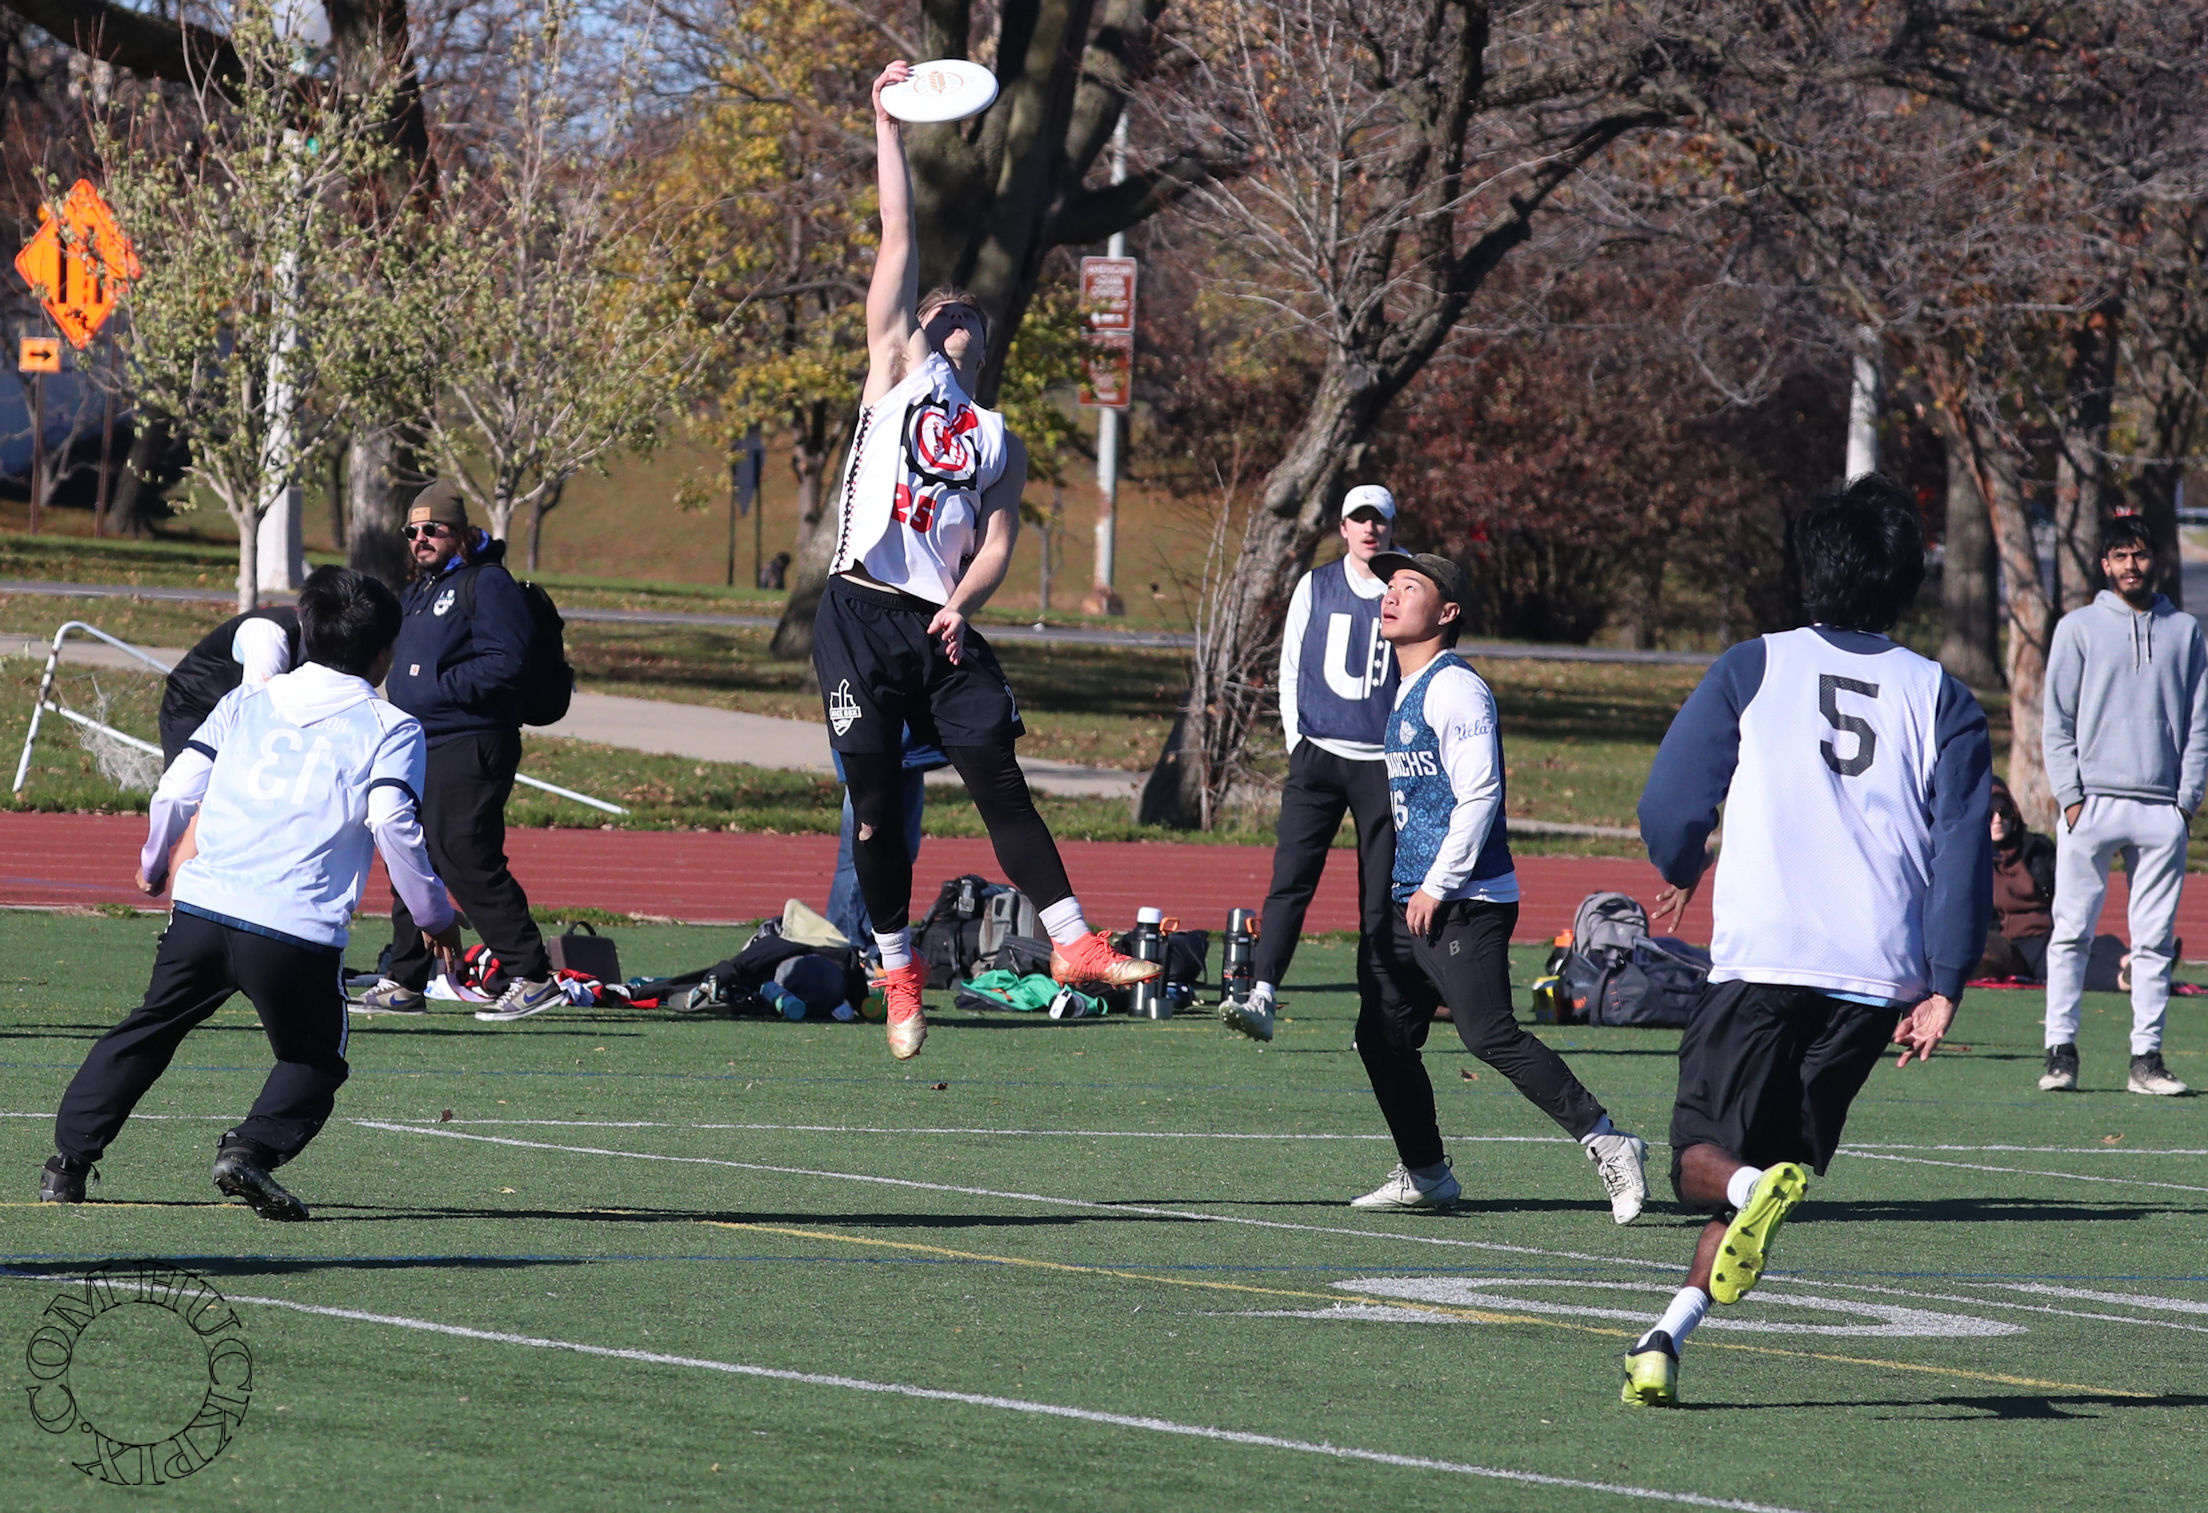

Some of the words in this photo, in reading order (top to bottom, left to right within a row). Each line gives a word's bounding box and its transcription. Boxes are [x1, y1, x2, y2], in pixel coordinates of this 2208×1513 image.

[892, 482, 937, 534] 25
[1324, 612, 1391, 700] U
[1819, 672, 1880, 778] 5
